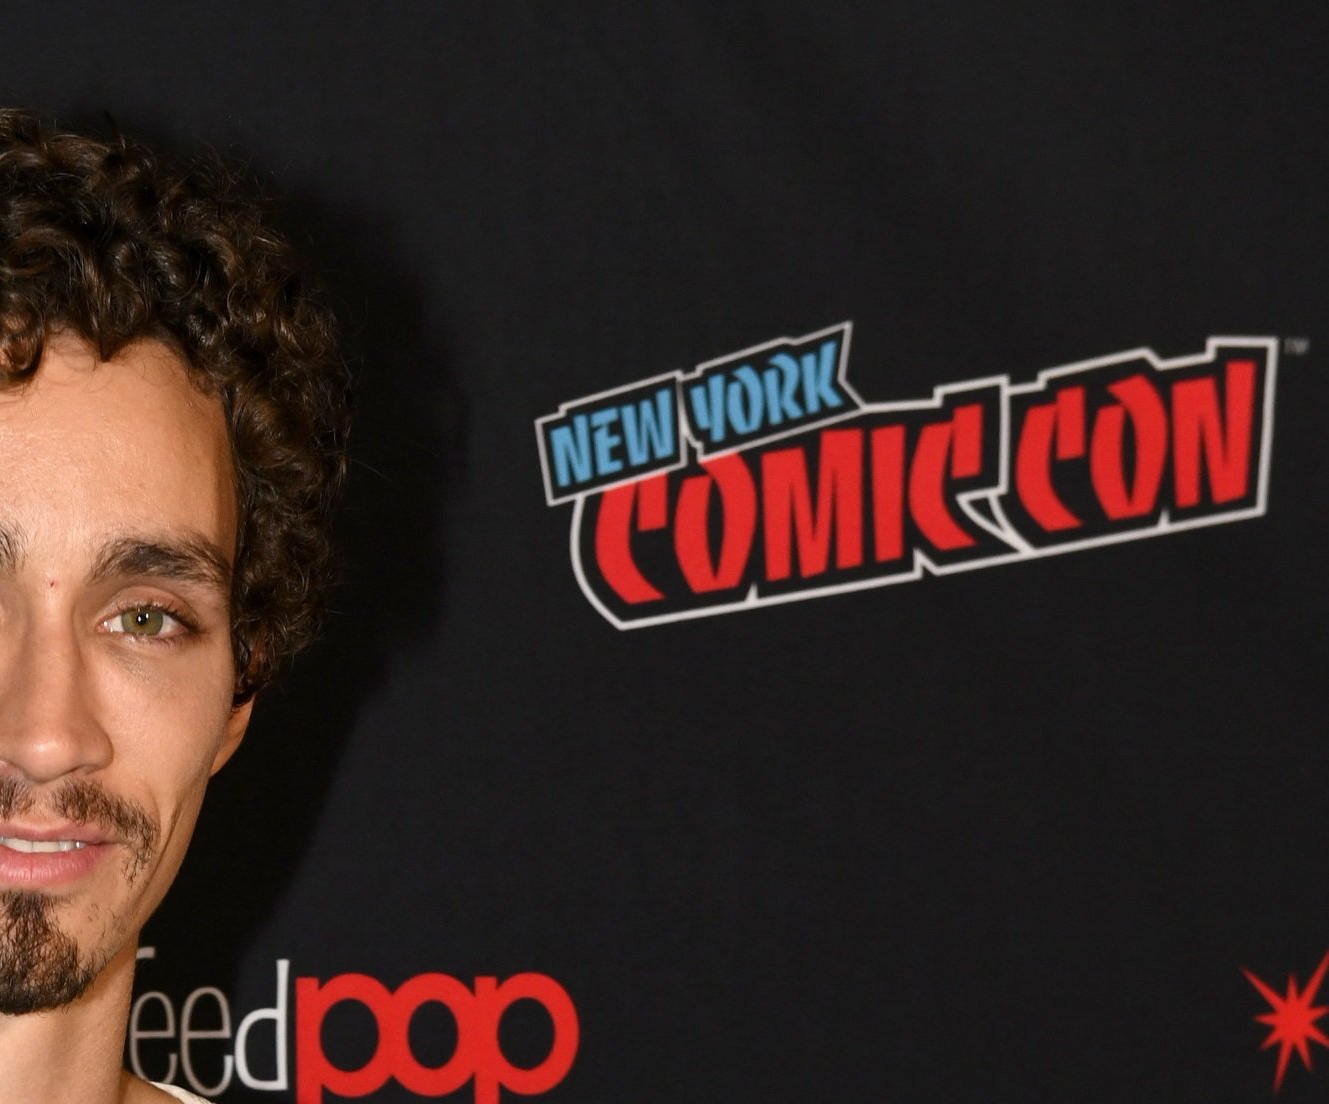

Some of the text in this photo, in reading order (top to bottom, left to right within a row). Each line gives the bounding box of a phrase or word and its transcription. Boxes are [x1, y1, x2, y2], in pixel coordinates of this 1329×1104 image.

[549, 340, 843, 488] NEW YORK
[594, 403, 985, 605] COMIC
[1014, 360, 1258, 533] CON
